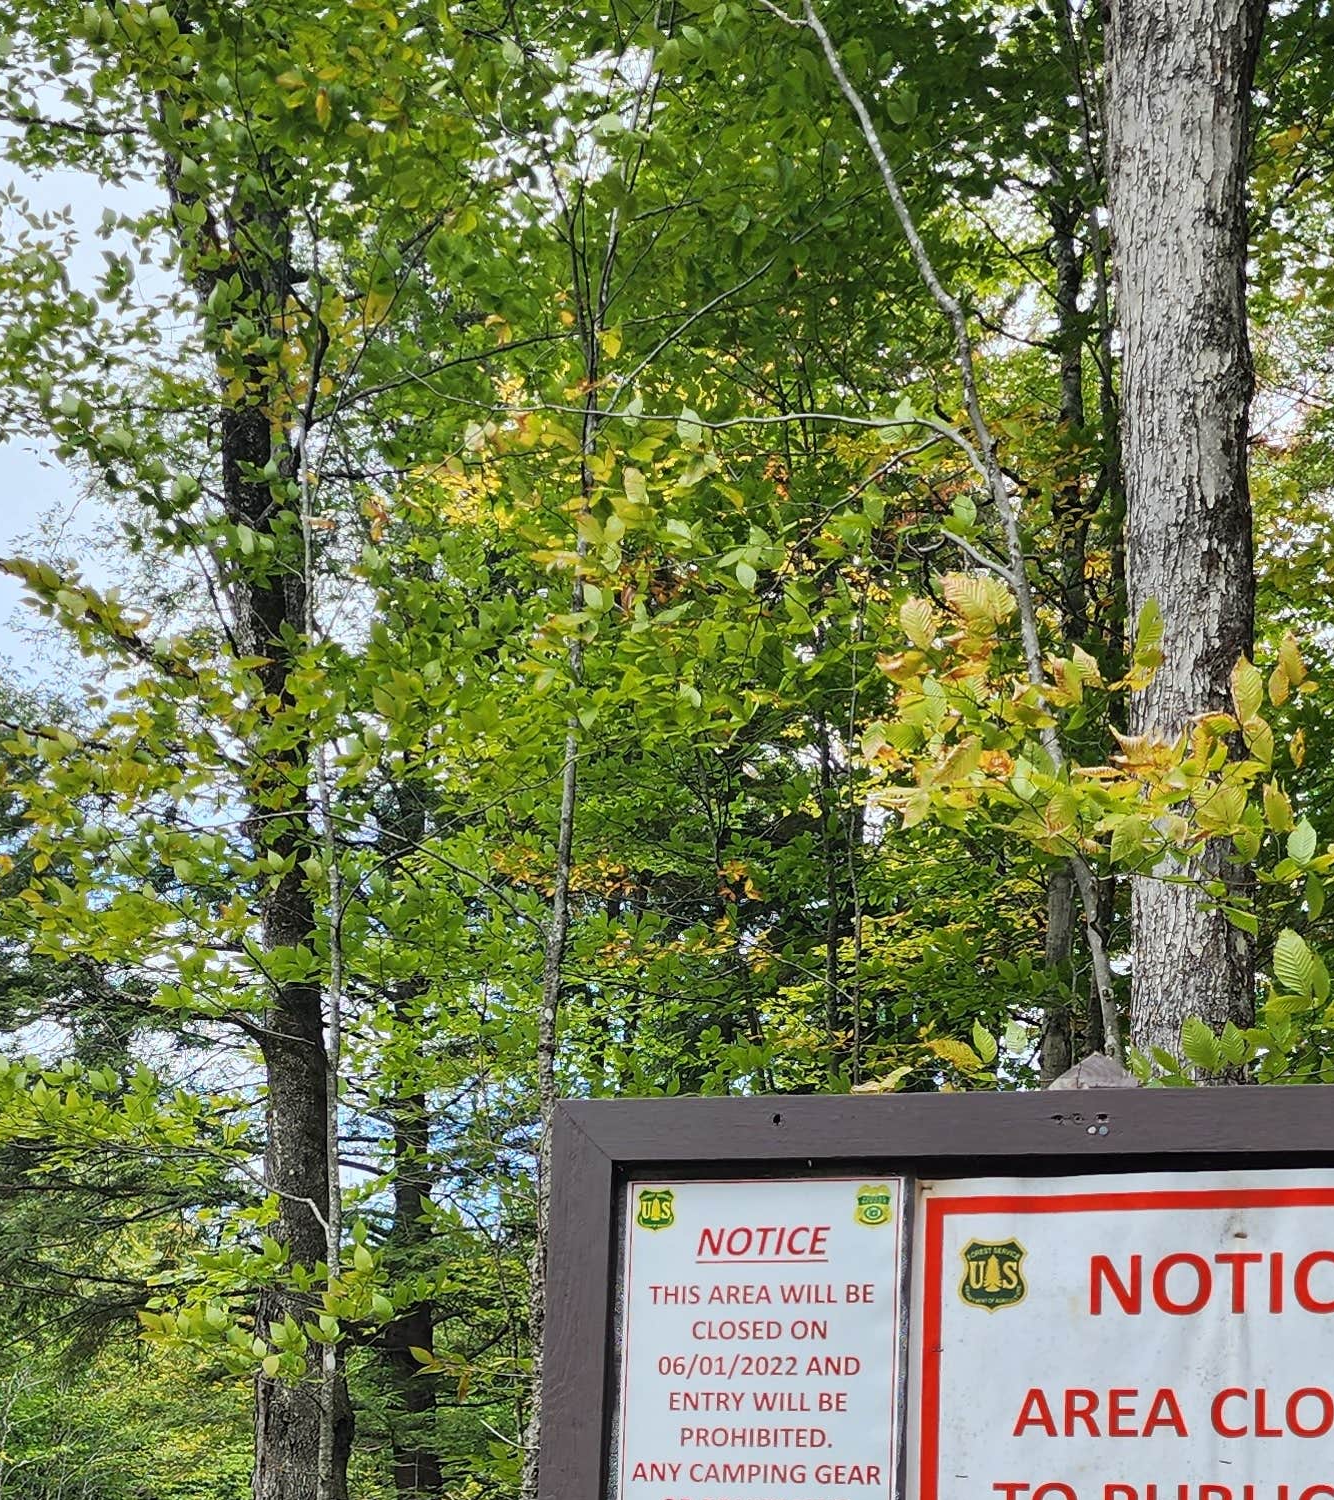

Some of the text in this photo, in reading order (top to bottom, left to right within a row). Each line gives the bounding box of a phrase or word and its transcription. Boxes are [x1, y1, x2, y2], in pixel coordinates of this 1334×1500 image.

[698, 1227, 830, 1256] NOTICE
[649, 1284, 874, 1304] THIS AREA WILL BE
[693, 1321, 827, 1340] CLOSED ON
[659, 1354, 860, 1379] 06/01/2022 AND
[670, 1392, 847, 1412] ENTRY WILL BE
[1013, 1389, 1188, 1437] AREA
[681, 1428, 832, 1448] PROHIBITED.
[632, 1463, 880, 1485] ANY CAMPING GEAR
